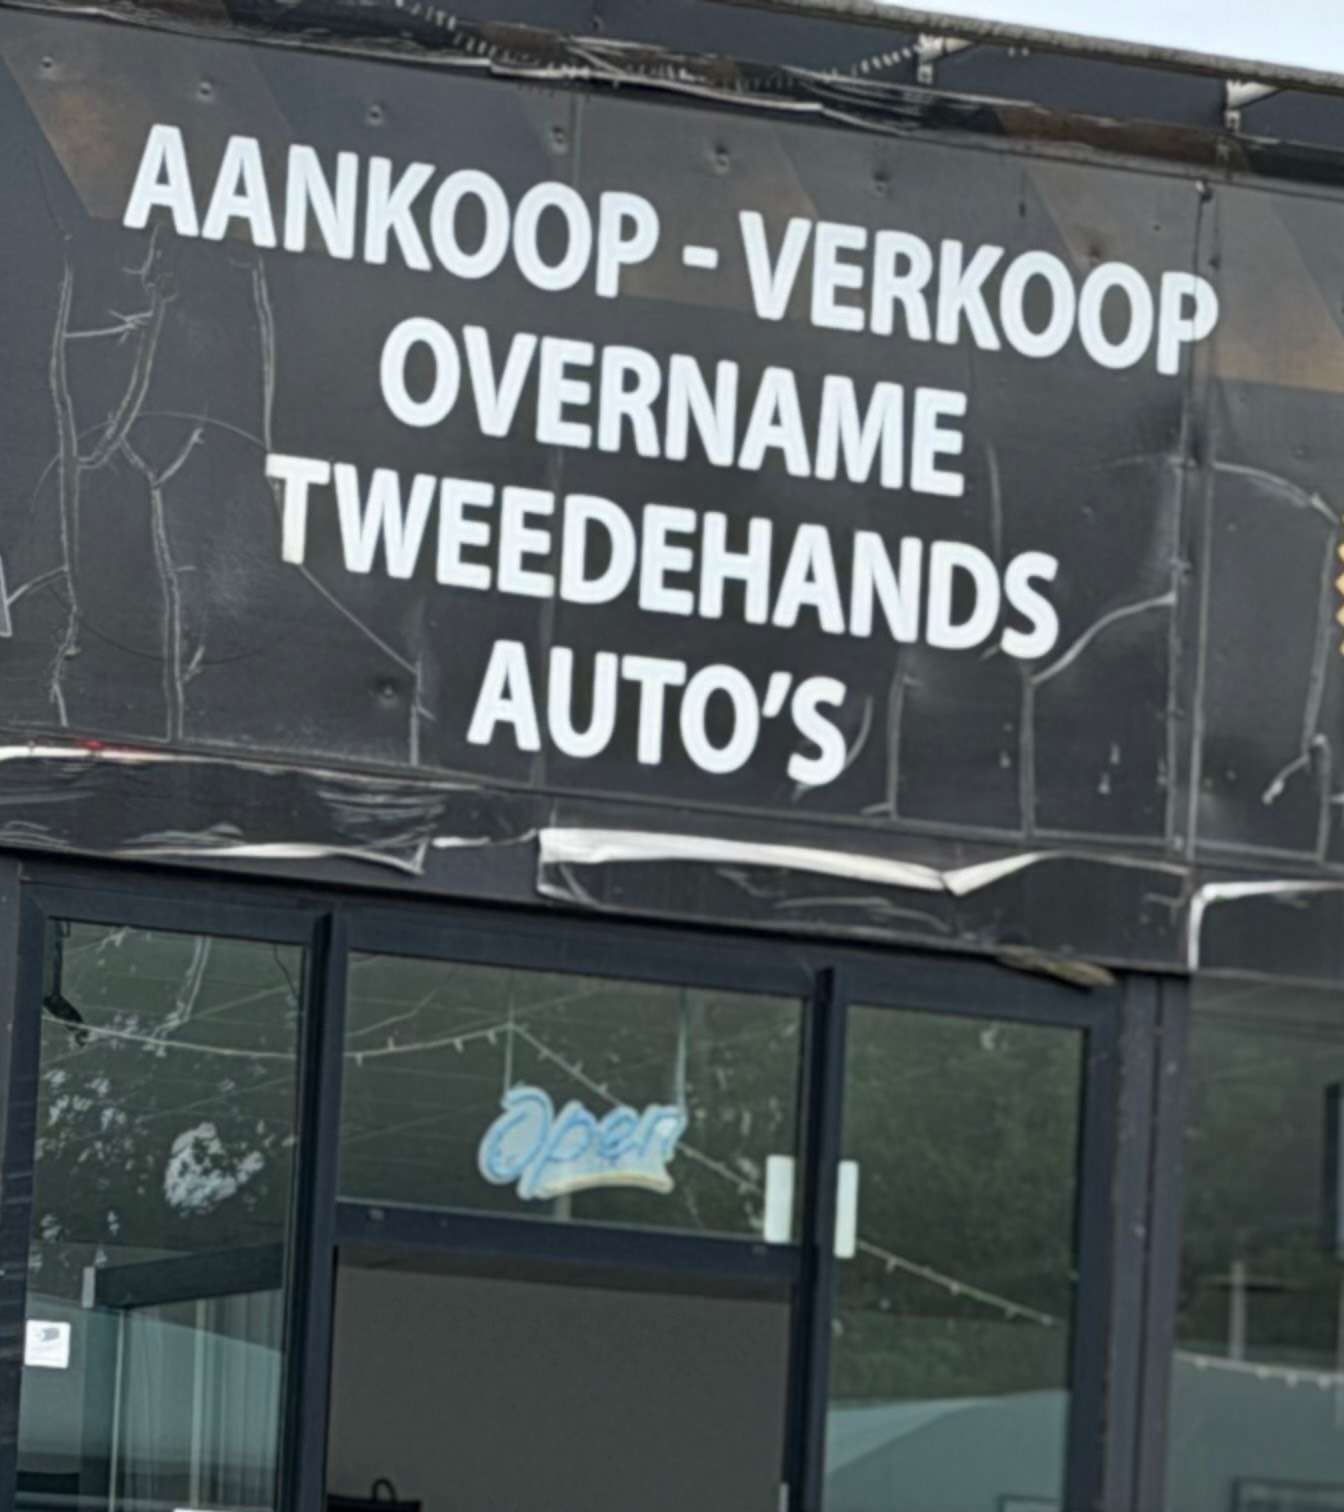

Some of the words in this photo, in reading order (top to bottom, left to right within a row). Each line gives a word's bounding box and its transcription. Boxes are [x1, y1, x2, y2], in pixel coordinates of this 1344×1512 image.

[123, 124, 660, 299] AANKOOP
[682, 244, 719, 270] -
[739, 210, 1219, 376] VERKOOP
[380, 316, 967, 497] OVERNAME
[265, 453, 1060, 660] TWEEDEHANDS
[466, 638, 848, 787] AUTO'S
[478, 1085, 688, 1200] Open
